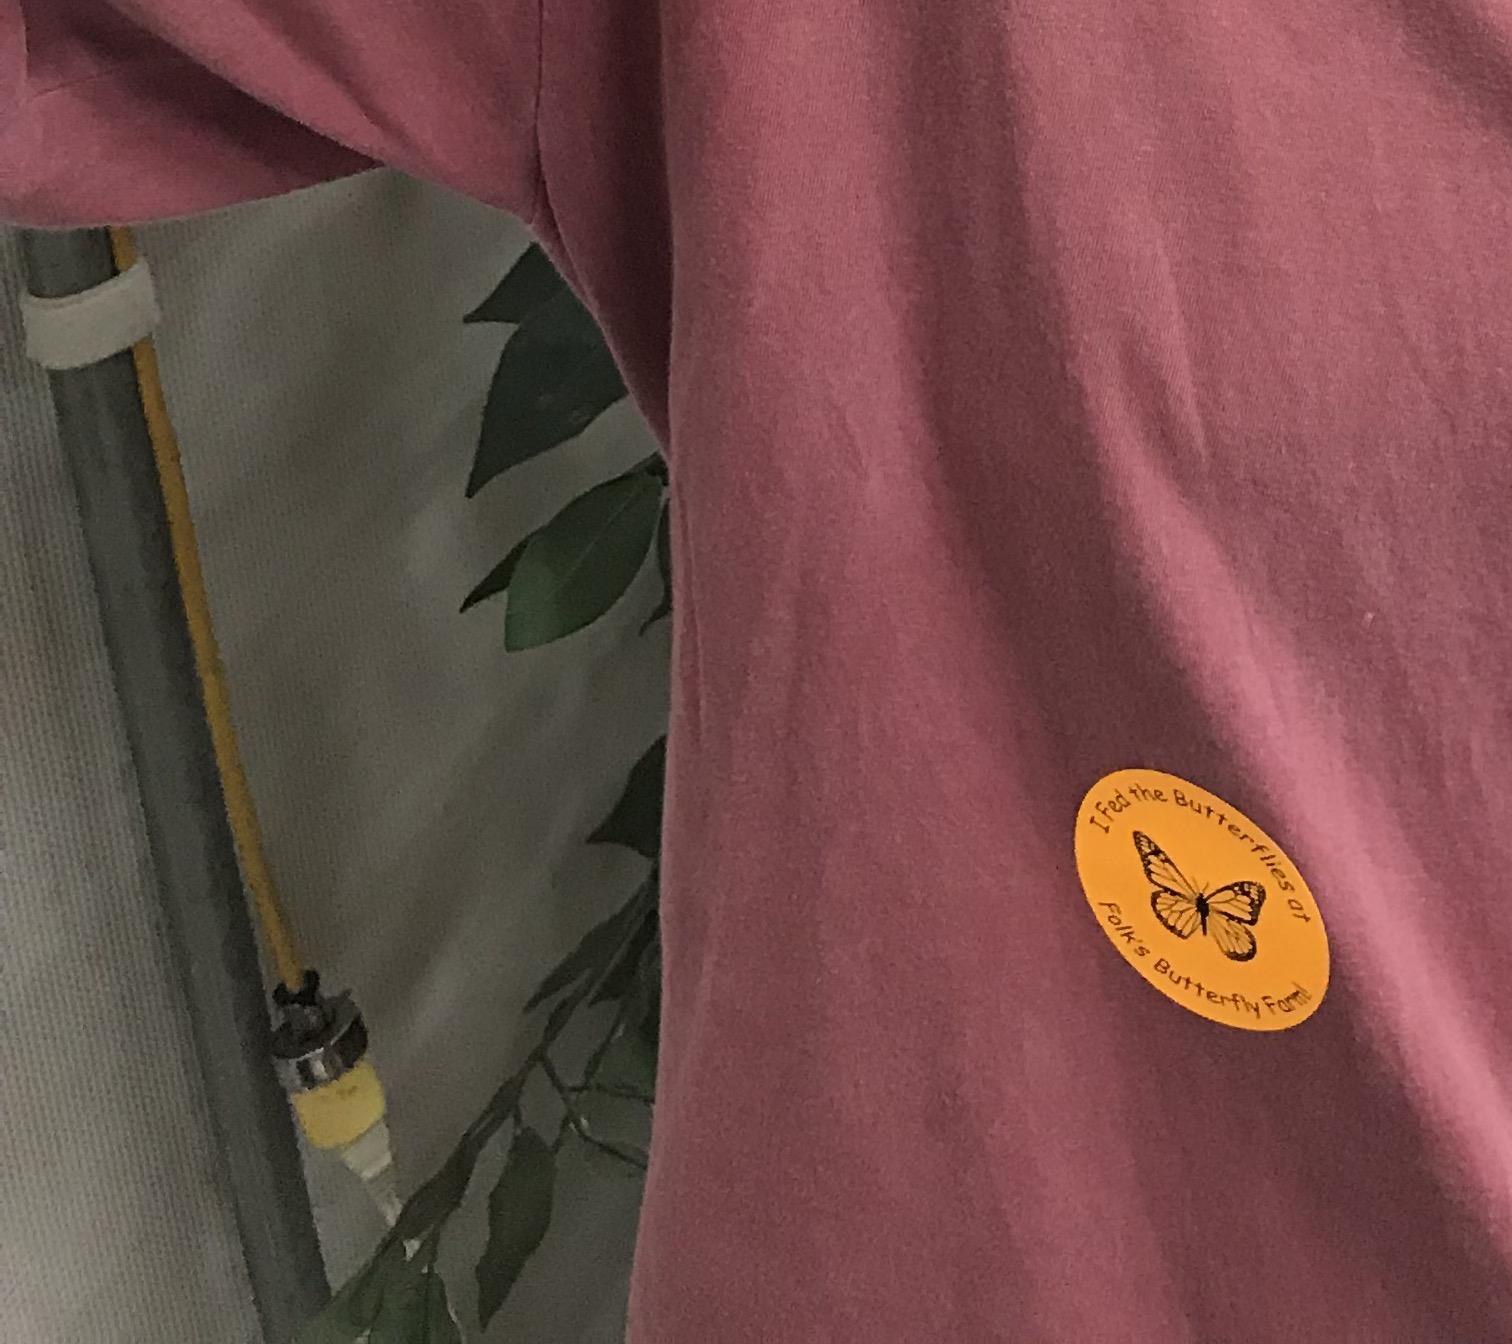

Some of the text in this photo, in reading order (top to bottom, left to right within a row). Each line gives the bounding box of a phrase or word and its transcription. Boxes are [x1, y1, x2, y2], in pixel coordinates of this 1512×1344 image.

[1089, 815, 1110, 834] I
[1128, 782, 1168, 802] the
[1173, 789, 1295, 893] Butterflies
[1287, 899, 1311, 923] at
[1098, 902, 1151, 957] Folk's
[1153, 957, 1261, 1020] Butterfly
